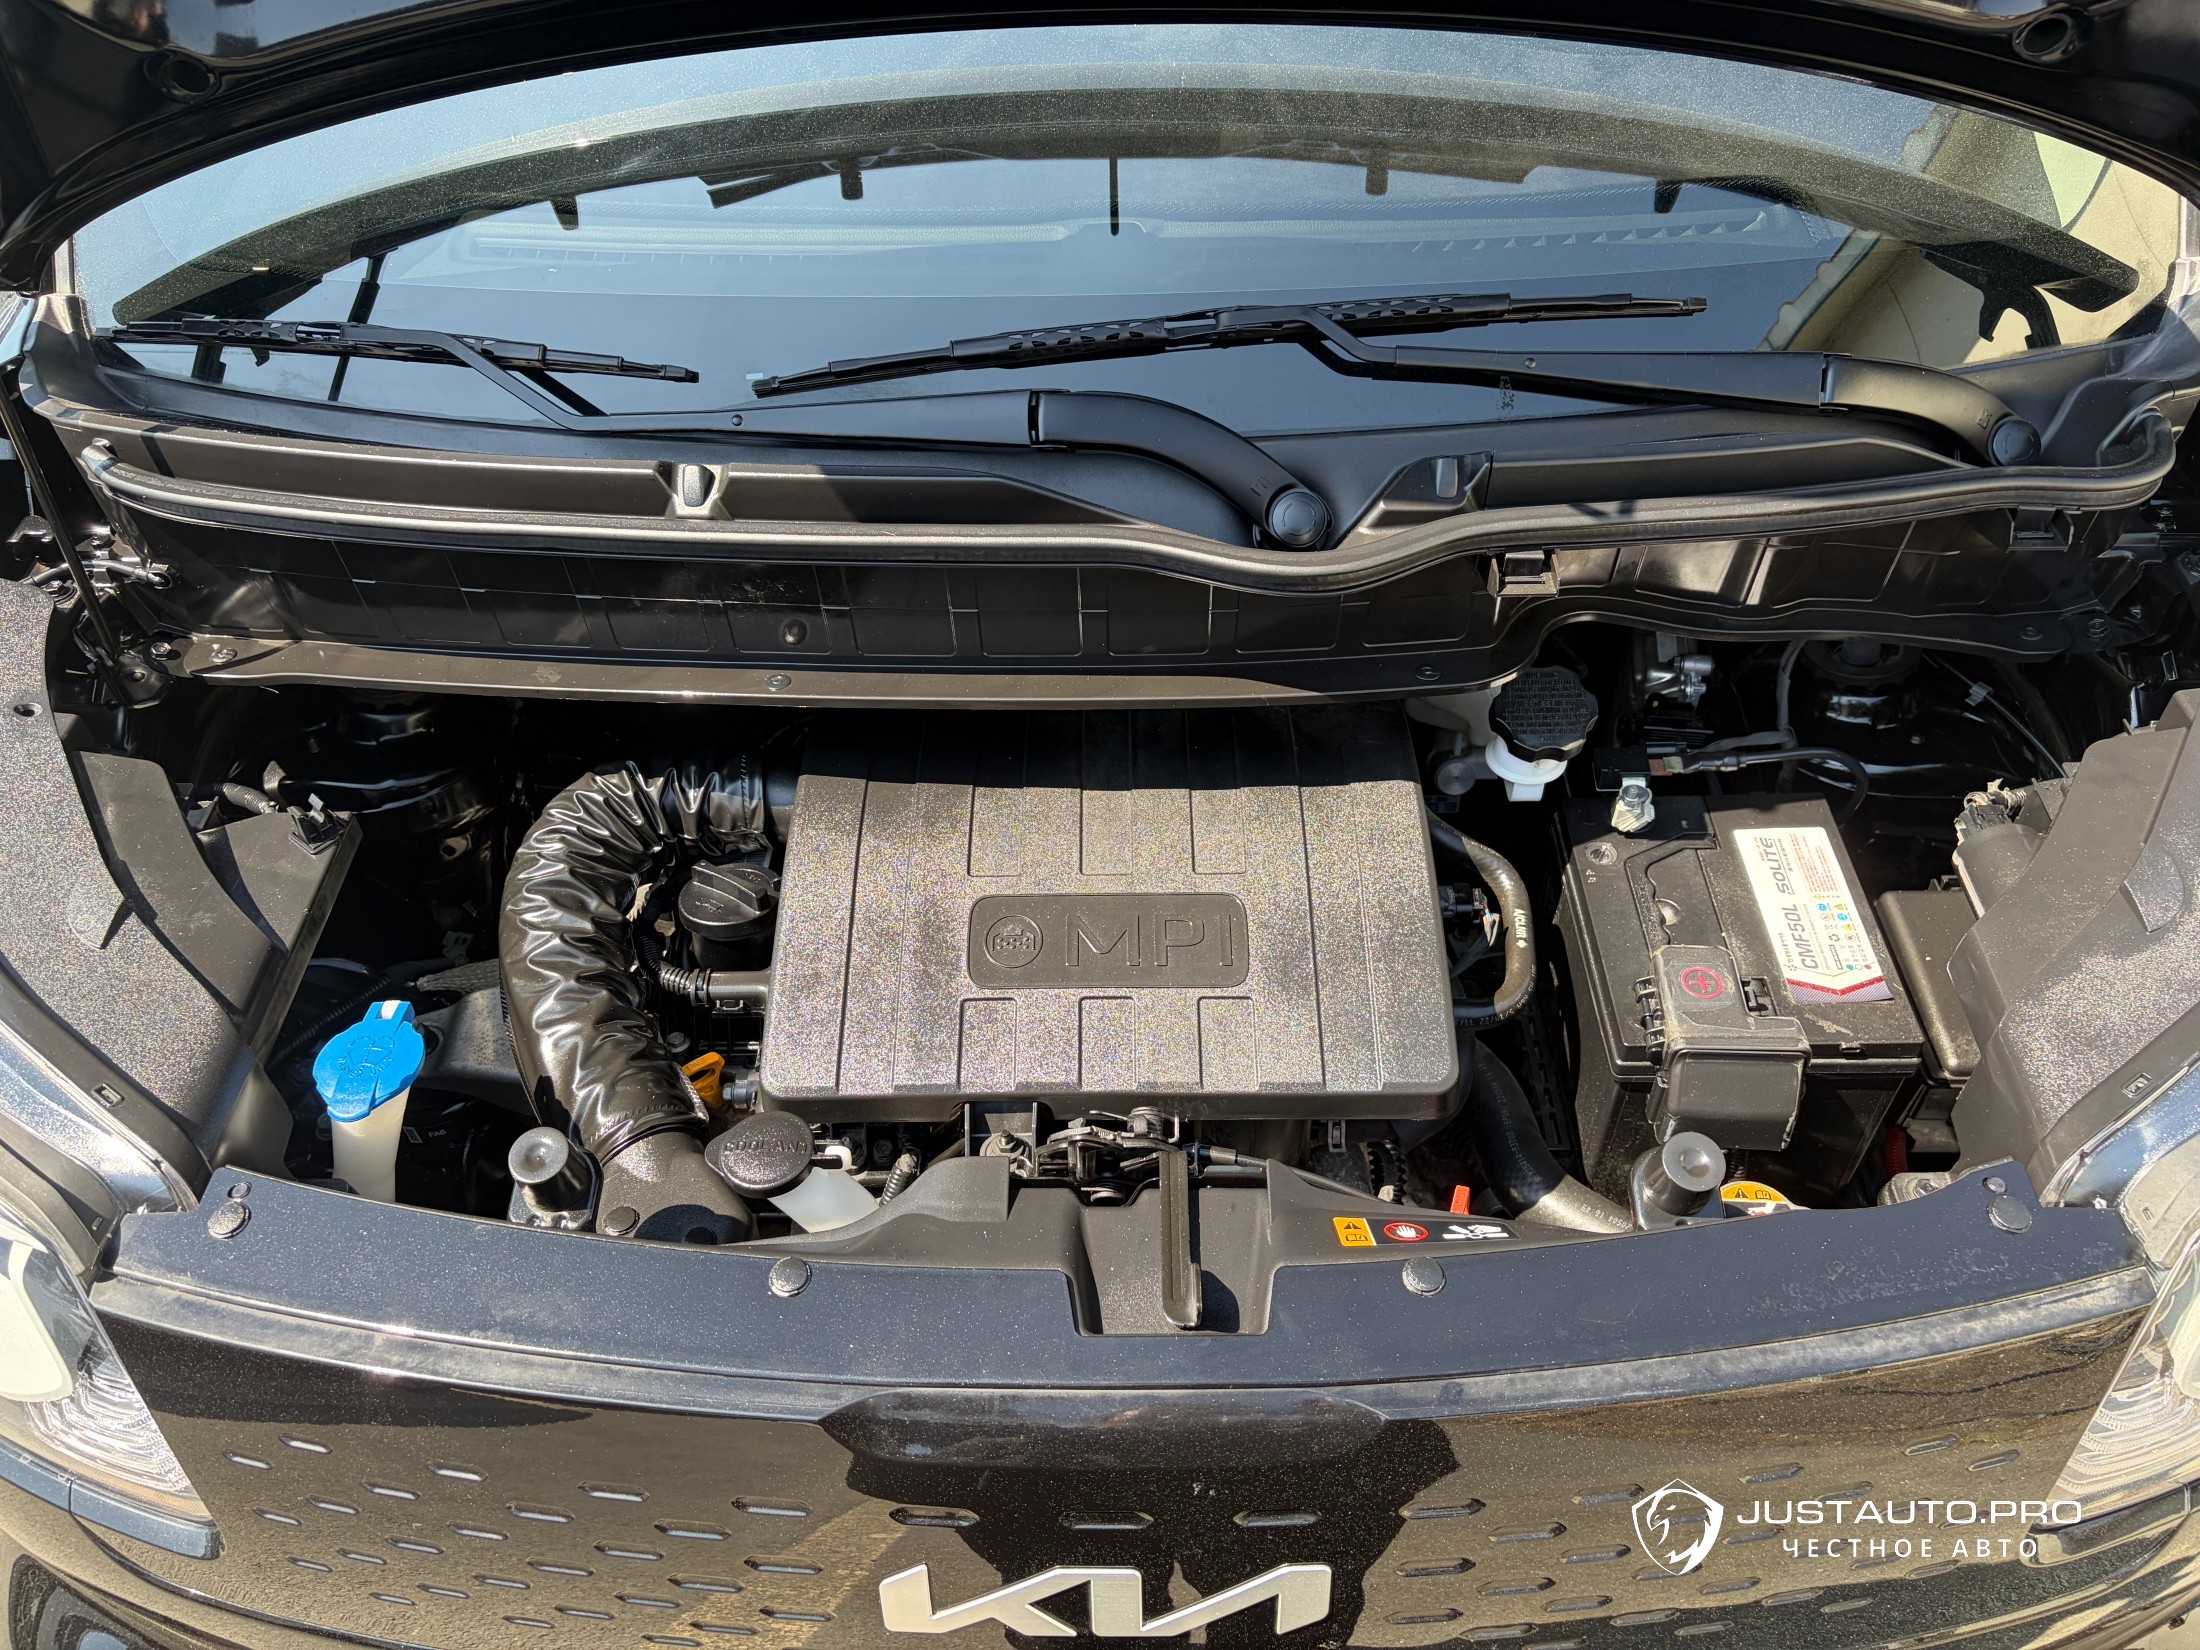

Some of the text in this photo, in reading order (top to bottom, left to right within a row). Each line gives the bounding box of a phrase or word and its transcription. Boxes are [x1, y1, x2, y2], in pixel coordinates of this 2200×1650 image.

[1759, 837, 1791, 895] SOLITE
[1065, 913, 1233, 966] MPI
[1782, 903, 1819, 970] CMF50L
[725, 1140, 811, 1153] COOLANT
[879, 1563, 1332, 1637] KIA
